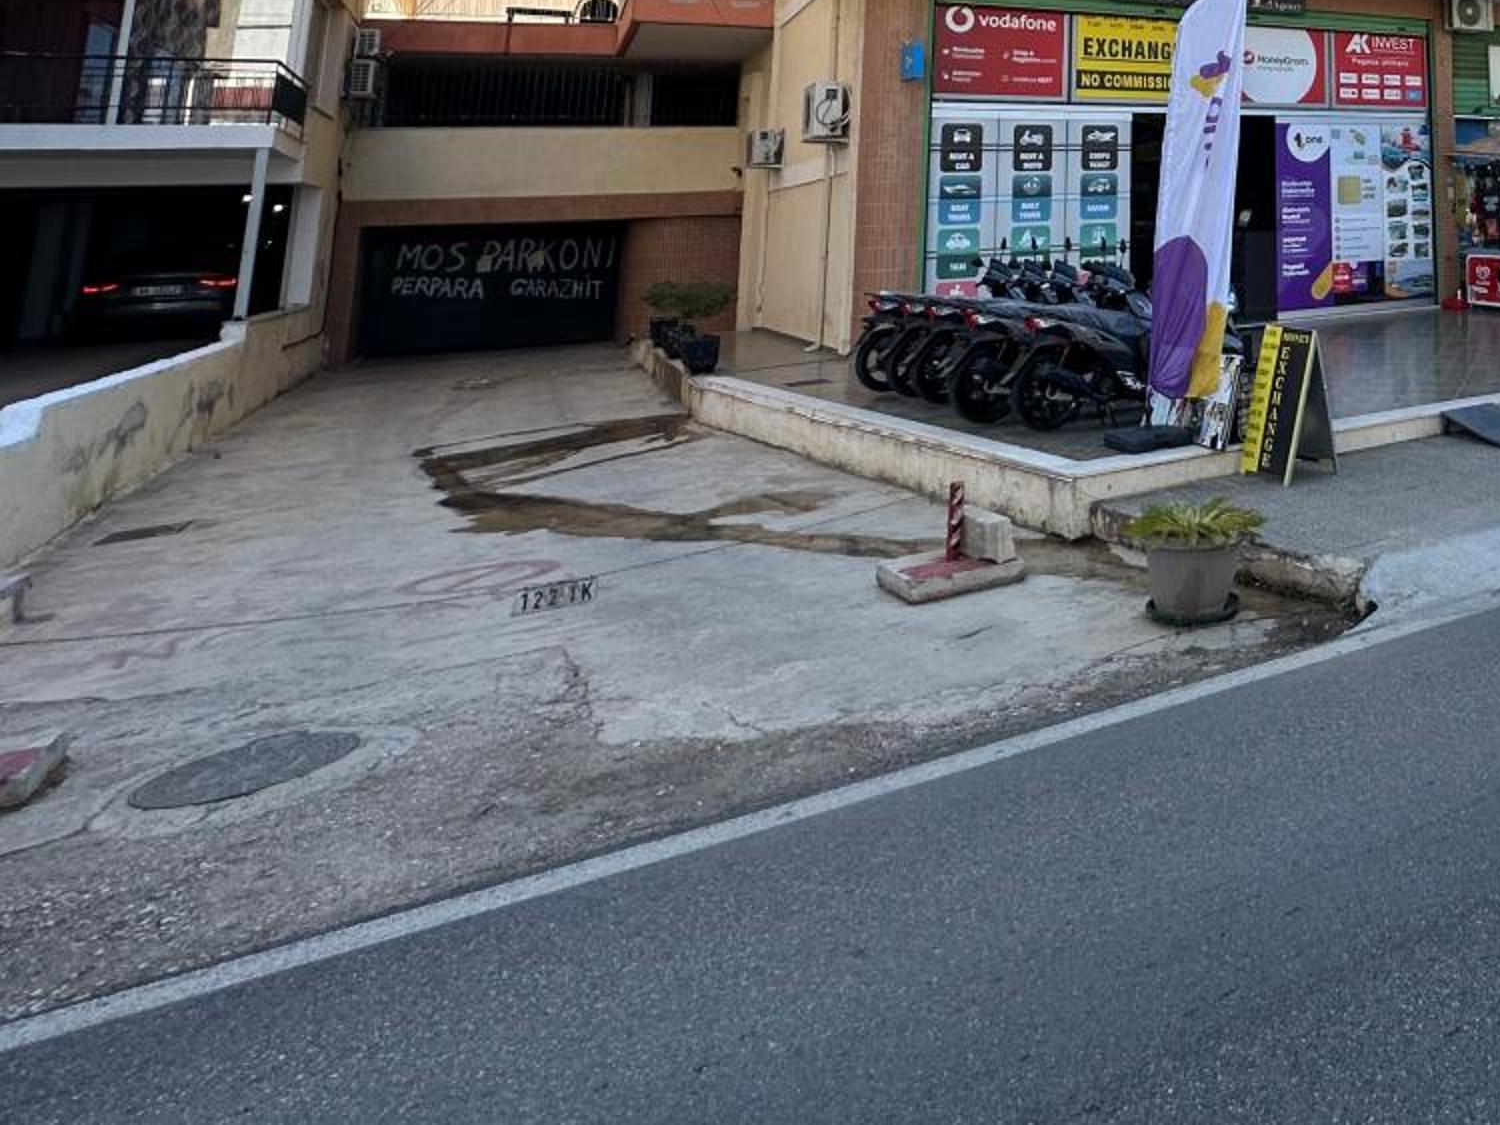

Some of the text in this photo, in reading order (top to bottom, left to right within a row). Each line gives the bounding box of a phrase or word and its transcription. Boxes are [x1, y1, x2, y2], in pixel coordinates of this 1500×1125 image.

[978, 13, 1057, 32] vodafone
[1083, 37, 1175, 61] EXCHANG
[1371, 36, 1415, 51] INVEST
[1257, 54, 1309, 68] MoneyGram
[1080, 73, 1172, 92] NO COMMISSI
[396, 236, 616, 274] MOS PARKONI
[391, 274, 604, 300] PERPARA GARAZHIT
